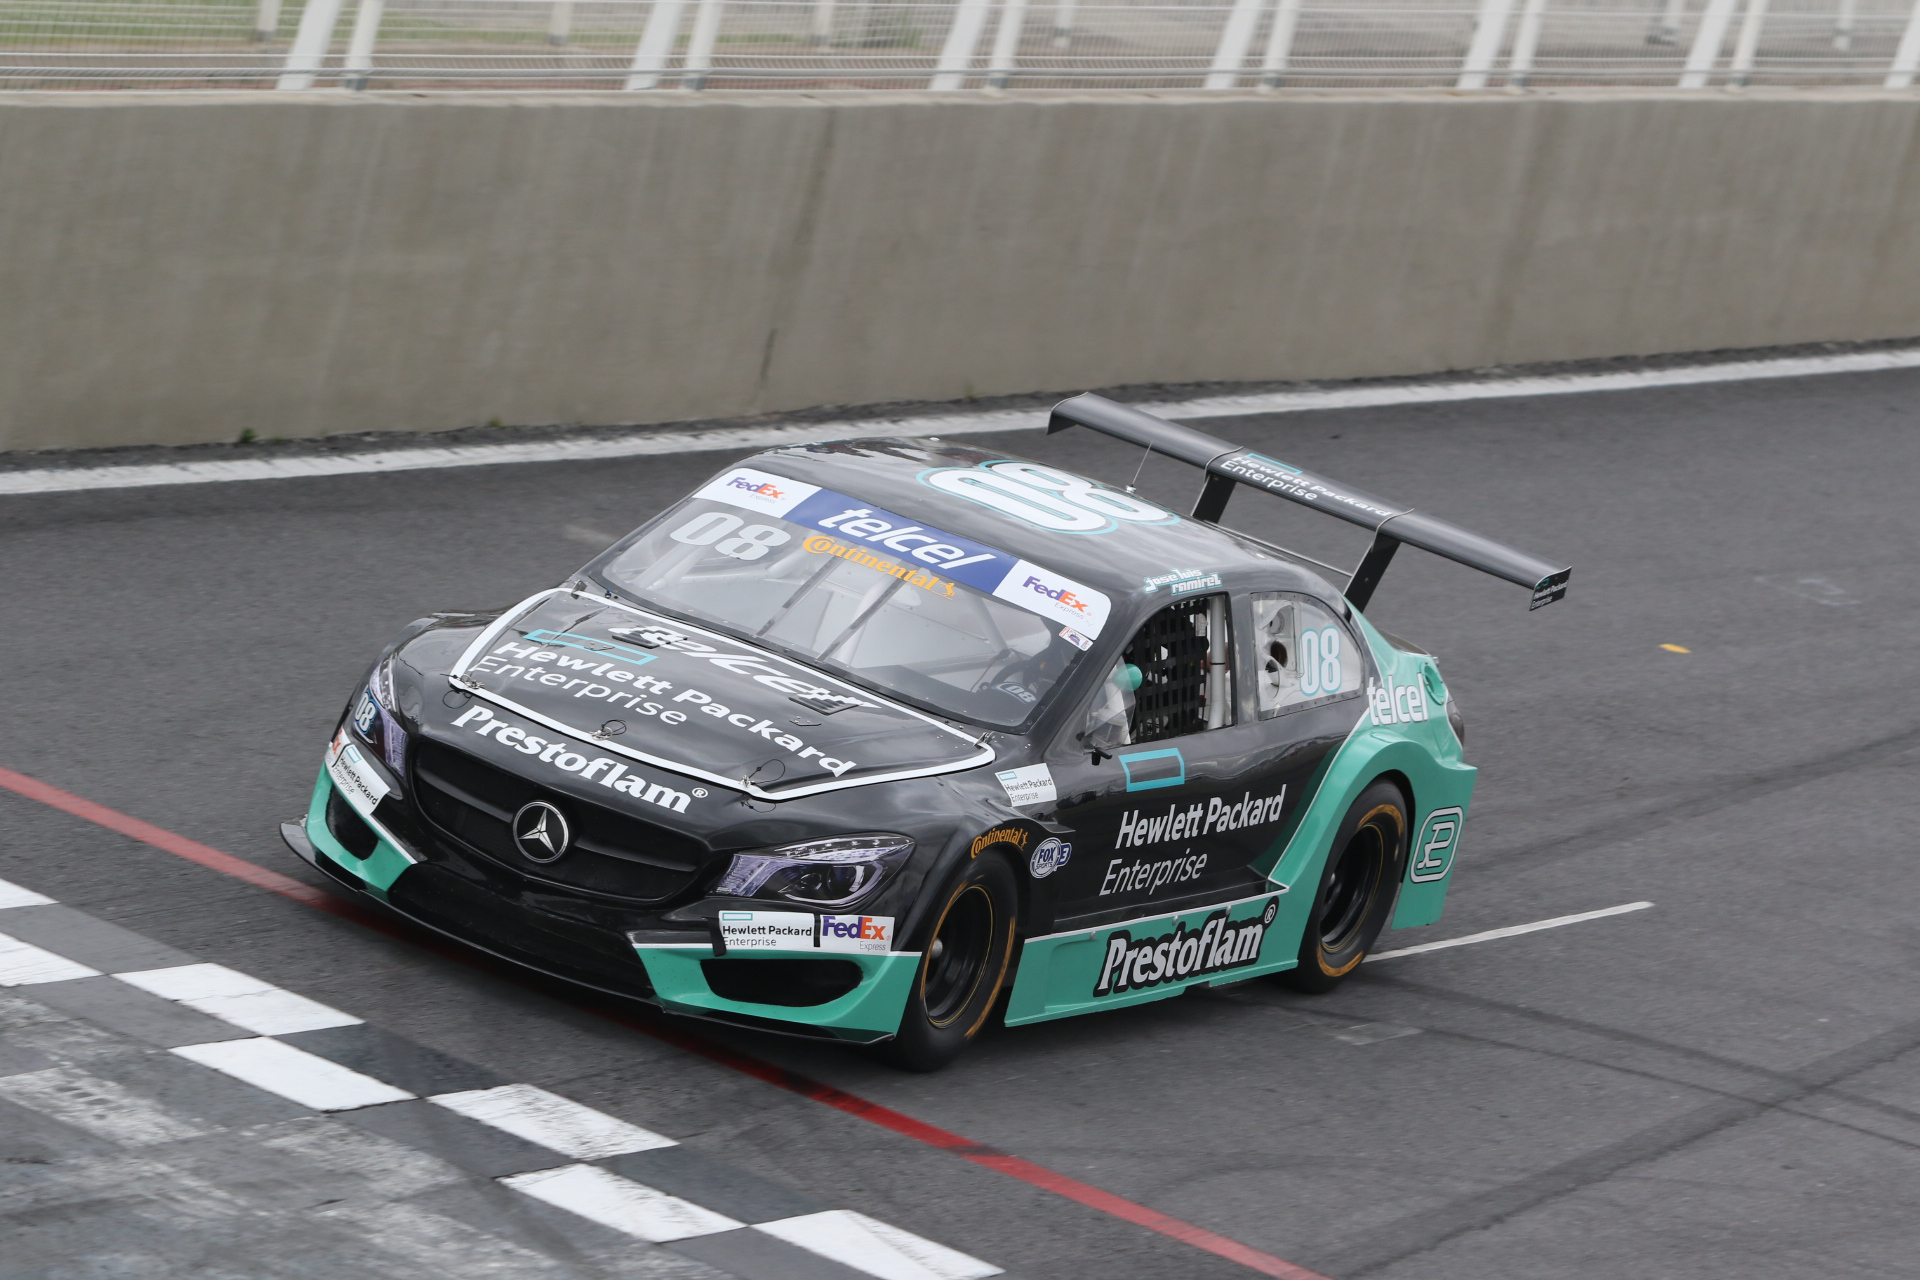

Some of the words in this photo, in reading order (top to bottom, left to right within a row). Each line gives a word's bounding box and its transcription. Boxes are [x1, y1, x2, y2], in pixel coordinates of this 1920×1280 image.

[726, 476, 785, 499] FedEx
[1220, 459, 1319, 501] Enterprise
[1231, 456, 1311, 487] Hewlett
[1310, 484, 1393, 517] Packard
[669, 511, 791, 561] 08
[817, 508, 997, 570] telcel
[803, 535, 941, 592] Continental
[1022, 575, 1088, 612] FedEx
[1054, 602, 1085, 620] Express
[1300, 625, 1342, 697] 08
[468, 655, 688, 726] Enterprise
[493, 641, 674, 694] Hewlett
[671, 689, 857, 778] Packard
[1367, 672, 1429, 726] telcel
[354, 689, 379, 734] 08
[354, 775, 379, 805] Packard
[1010, 790, 1039, 802] Enterprise
[1028, 777, 1053, 789] Packard
[1115, 802, 1204, 849] Hewlett
[1202, 783, 1287, 835] Packard
[970, 827, 1023, 859] Continental
[1038, 846, 1056, 863] FOX
[1099, 848, 1208, 896] Enterprise
[722, 925, 767, 936] Hewlett
[768, 926, 812, 937] Packard
[723, 937, 777, 947] Enterprise
[822, 915, 887, 941] FedEx
[859, 941, 887, 951] Express
